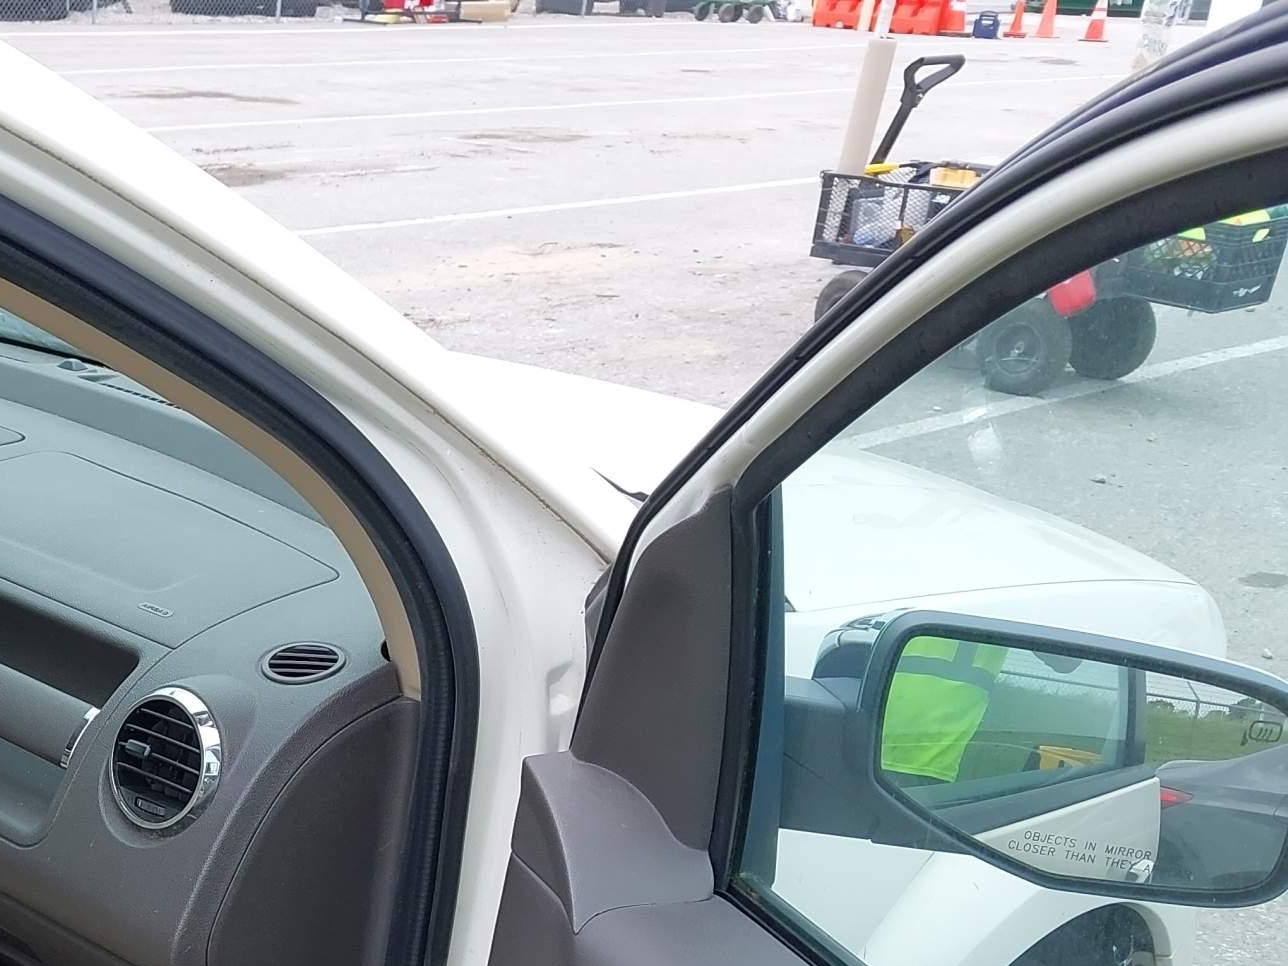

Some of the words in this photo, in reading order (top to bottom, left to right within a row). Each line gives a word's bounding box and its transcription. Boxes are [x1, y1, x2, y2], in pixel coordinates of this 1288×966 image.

[1008, 839, 1056, 857] CLOSER
[1065, 849, 1096, 864] THAN
[1024, 830, 1078, 848] OBJECTS
[1084, 840, 1097, 851] IN
[1104, 845, 1152, 860] MIRROR
